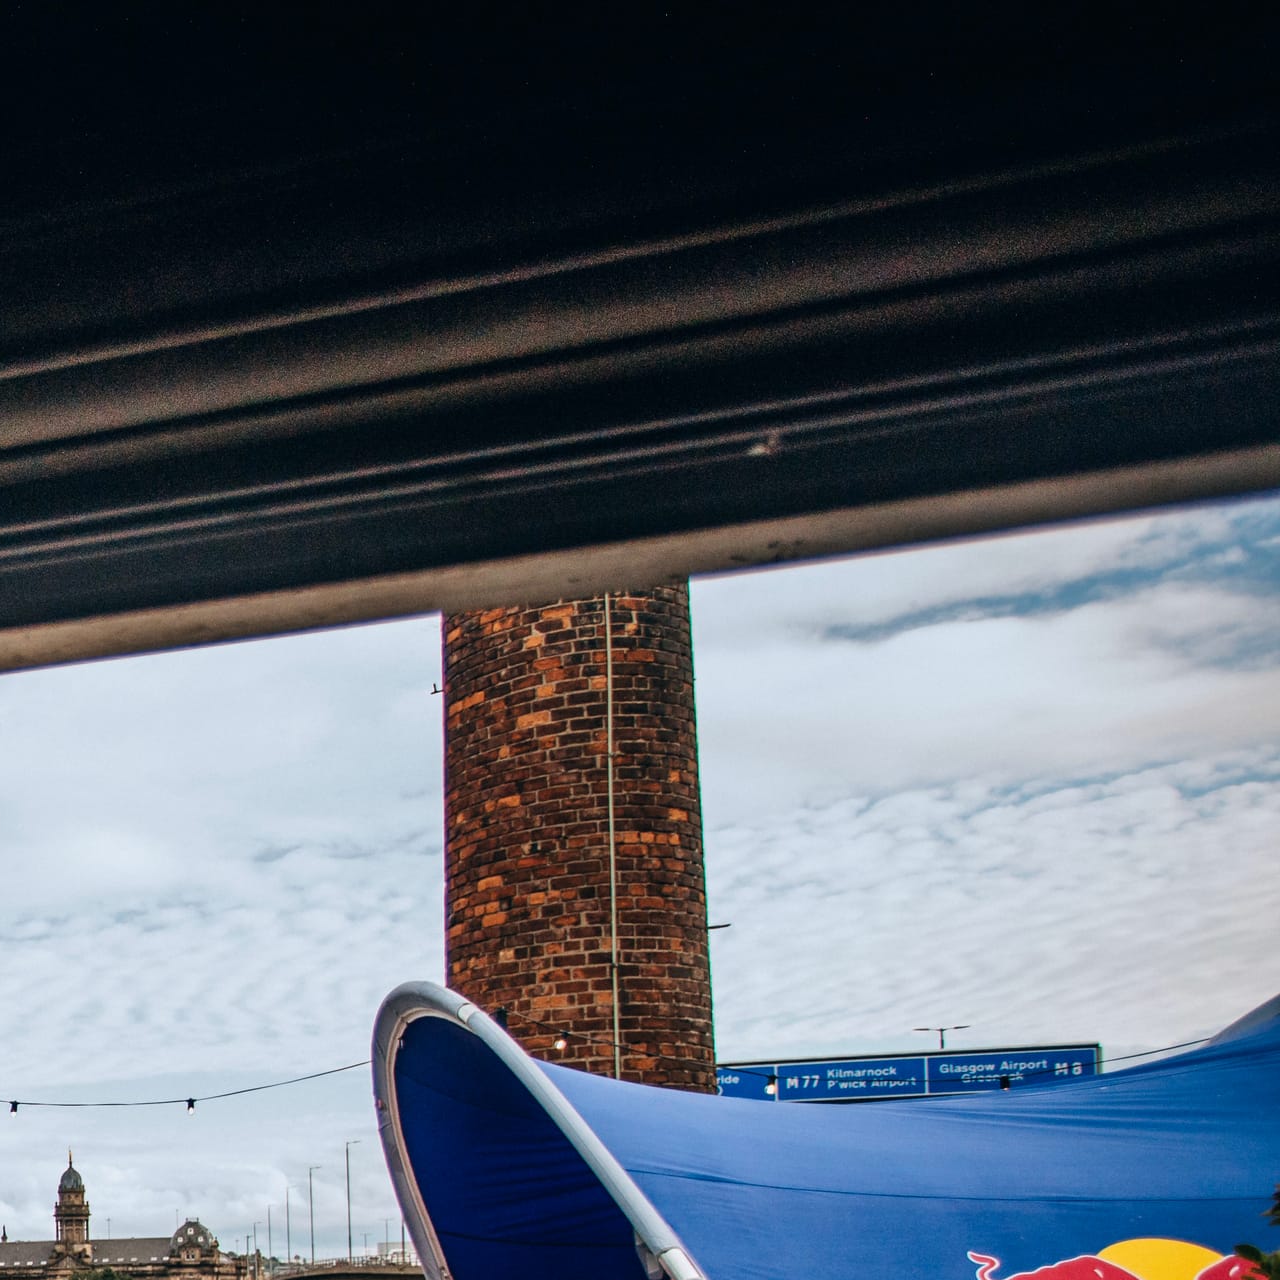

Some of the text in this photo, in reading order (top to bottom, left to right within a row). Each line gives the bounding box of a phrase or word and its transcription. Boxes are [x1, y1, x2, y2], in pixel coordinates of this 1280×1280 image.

[827, 1067, 897, 1079] Kilmarnock
[940, 1060, 1048, 1074] Glasgow Airport
